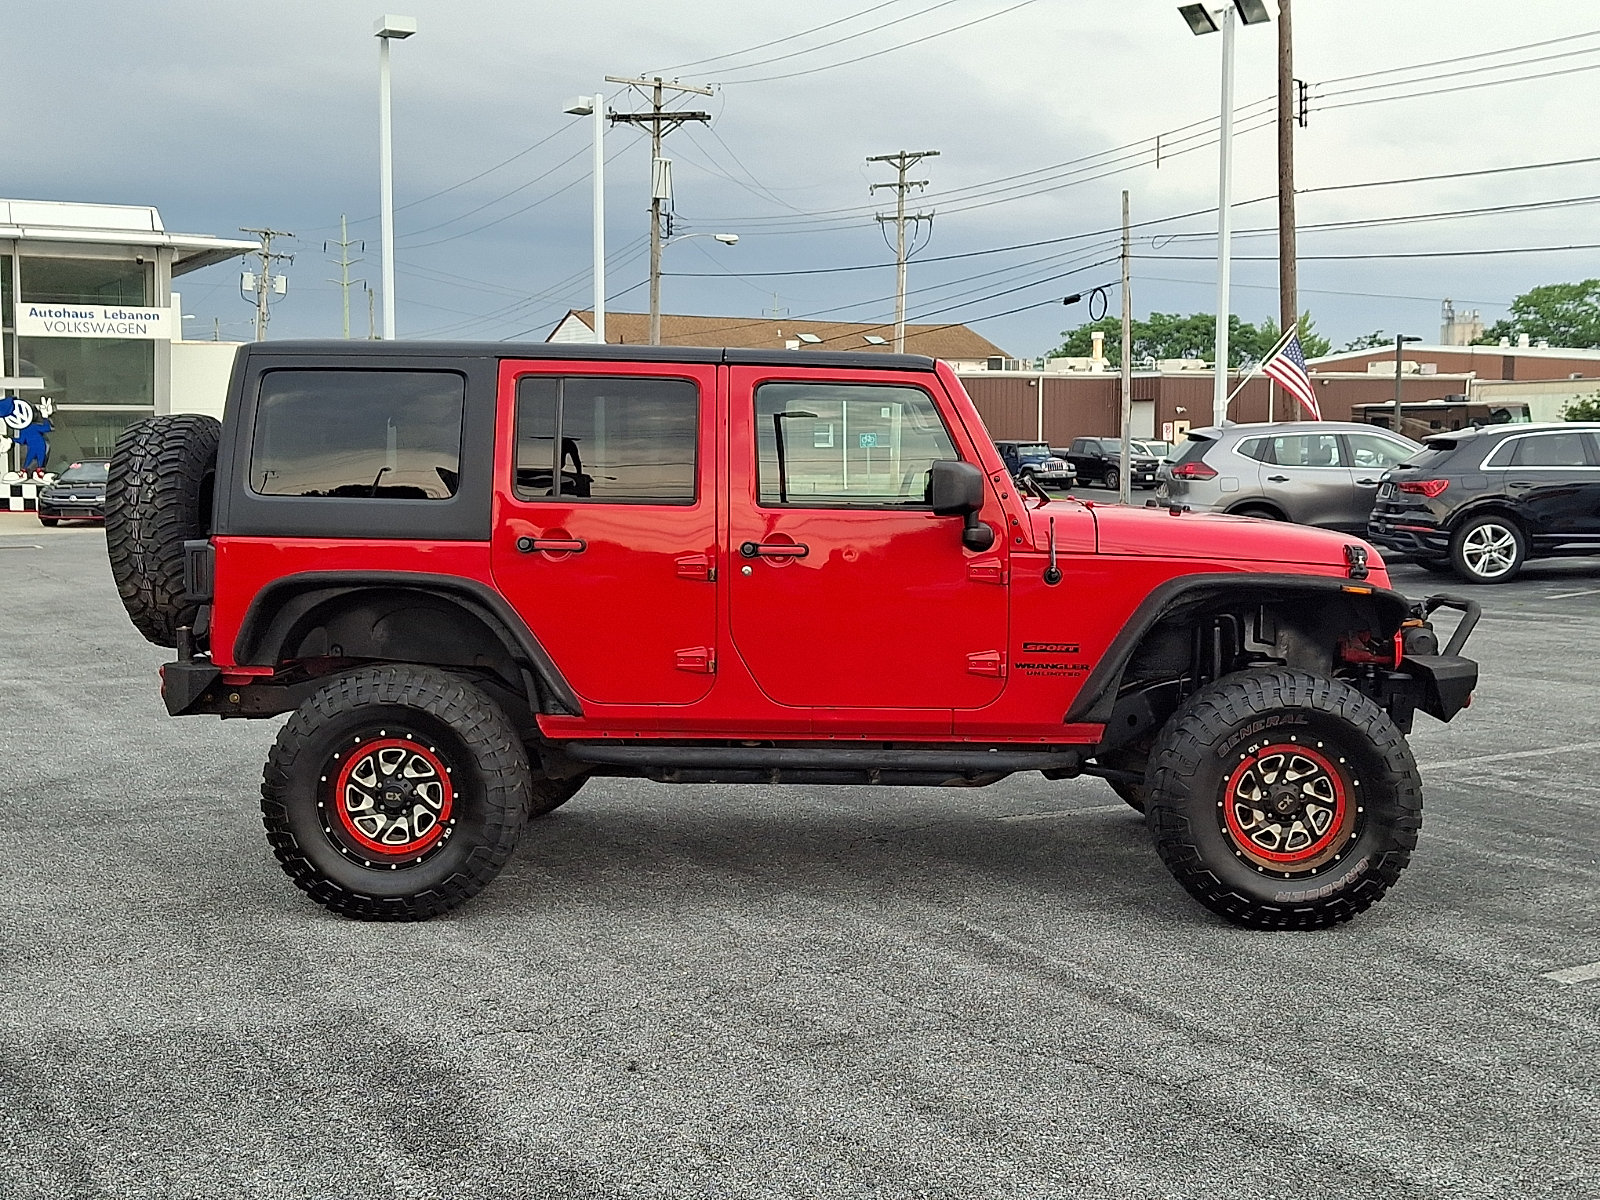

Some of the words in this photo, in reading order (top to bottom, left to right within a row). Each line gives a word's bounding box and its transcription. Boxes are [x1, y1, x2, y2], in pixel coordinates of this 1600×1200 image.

[29, 307, 95, 319] Autohaus
[104, 309, 160, 321] Lebanon
[44, 321, 147, 335] VOLKSWAGEN
[1024, 643, 1079, 652] SPORT
[1014, 663, 1090, 671] WRANGLER
[1217, 714, 1308, 758] GENERAL
[1275, 857, 1370, 903] GRABBER
